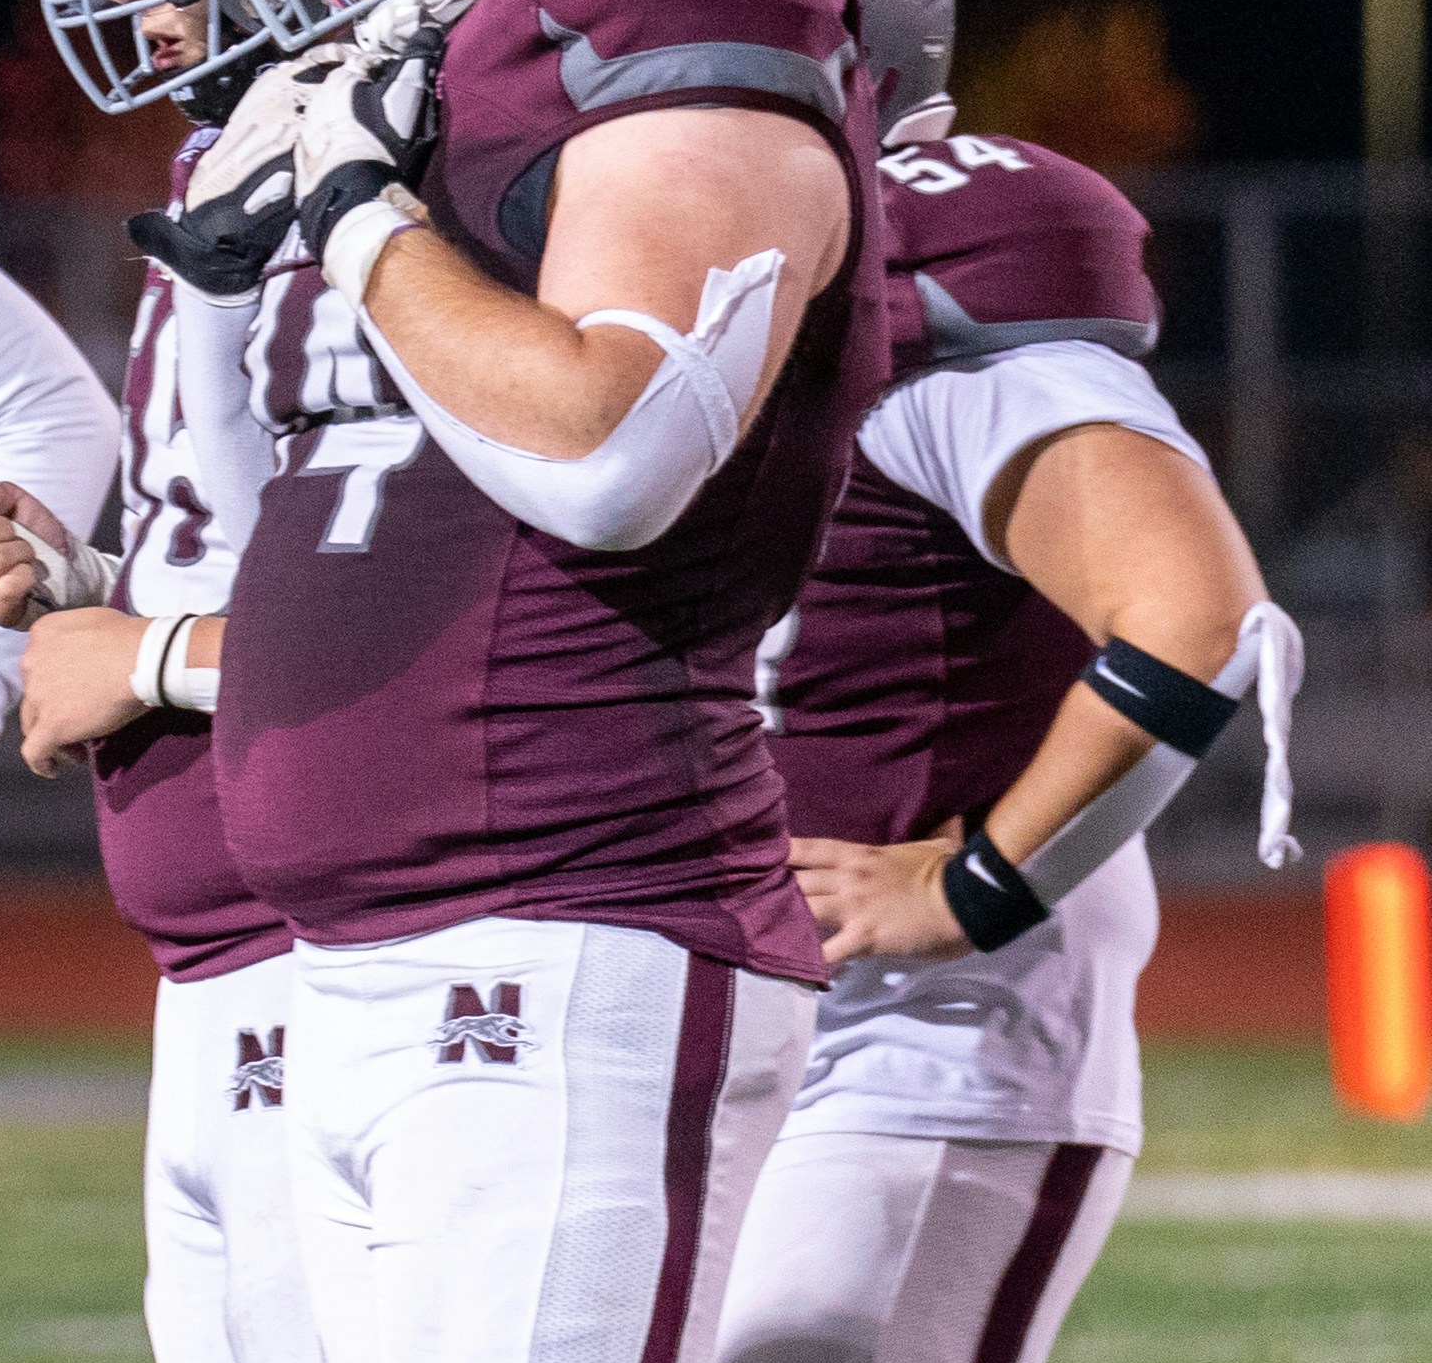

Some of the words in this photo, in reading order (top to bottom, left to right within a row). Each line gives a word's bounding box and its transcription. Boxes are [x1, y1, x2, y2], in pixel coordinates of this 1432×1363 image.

[877, 136, 1033, 194] 54
[437, 982, 522, 1066] N
[232, 1025, 286, 1112] N
